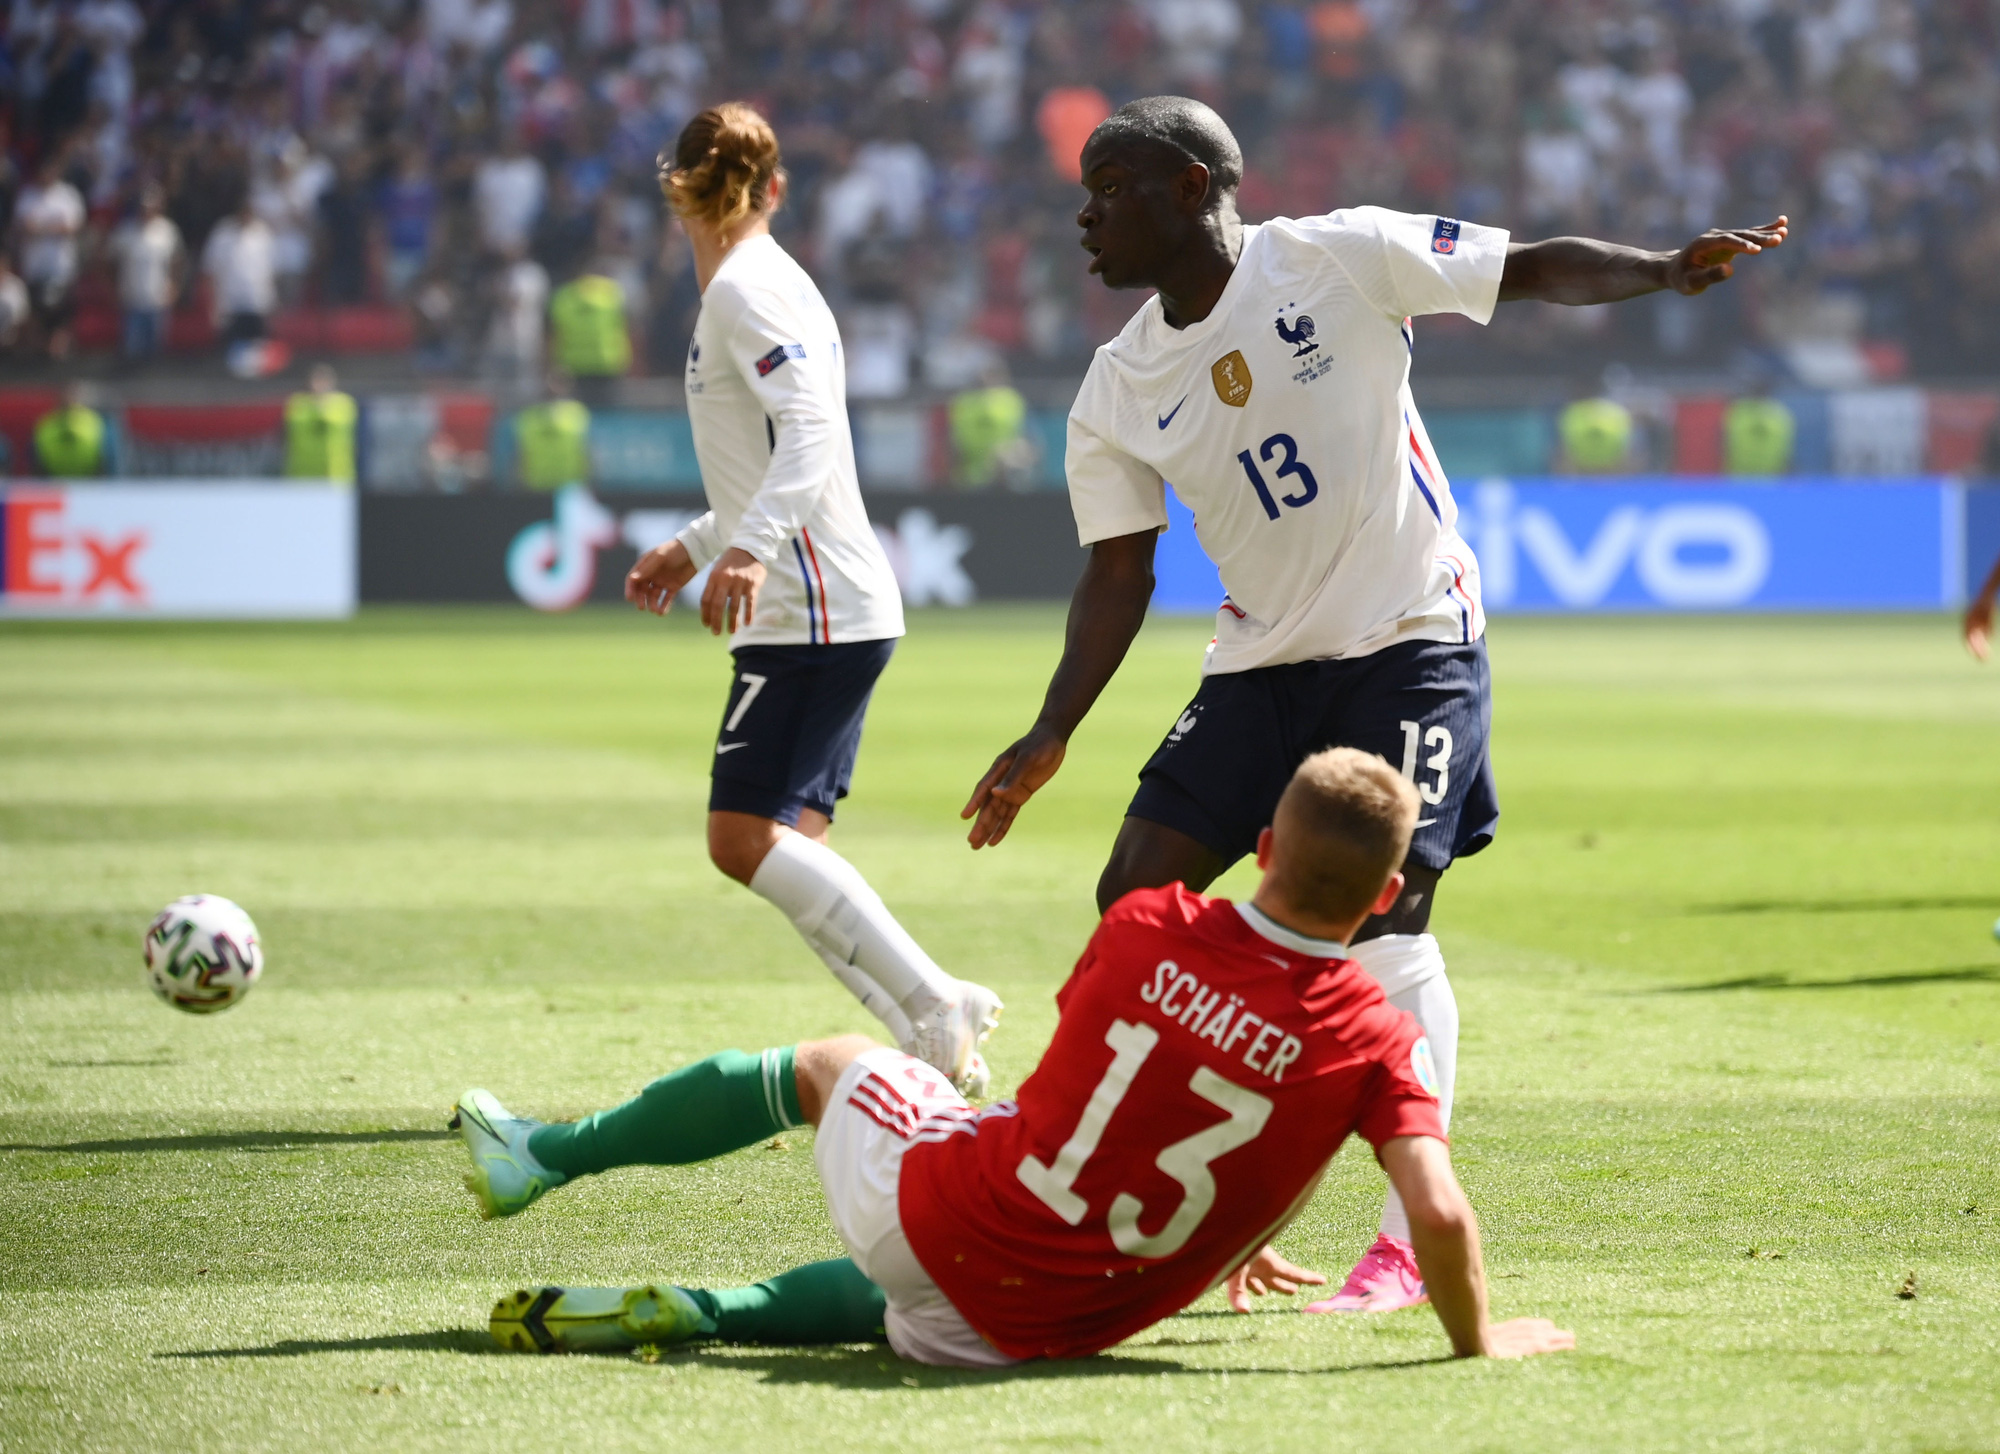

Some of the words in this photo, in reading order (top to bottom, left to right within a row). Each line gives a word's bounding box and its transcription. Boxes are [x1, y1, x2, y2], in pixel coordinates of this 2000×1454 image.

[1229, 384, 1245, 398] FIFA
[1237, 433, 1319, 521] 13
[0, 488, 148, 604] Ex
[1455, 482, 1773, 607] ivo
[725, 672, 768, 732] 7
[1400, 720, 1453, 806] 13
[1140, 959, 1303, 1083] SCHÄFER
[1015, 1017, 1274, 1259] 13
